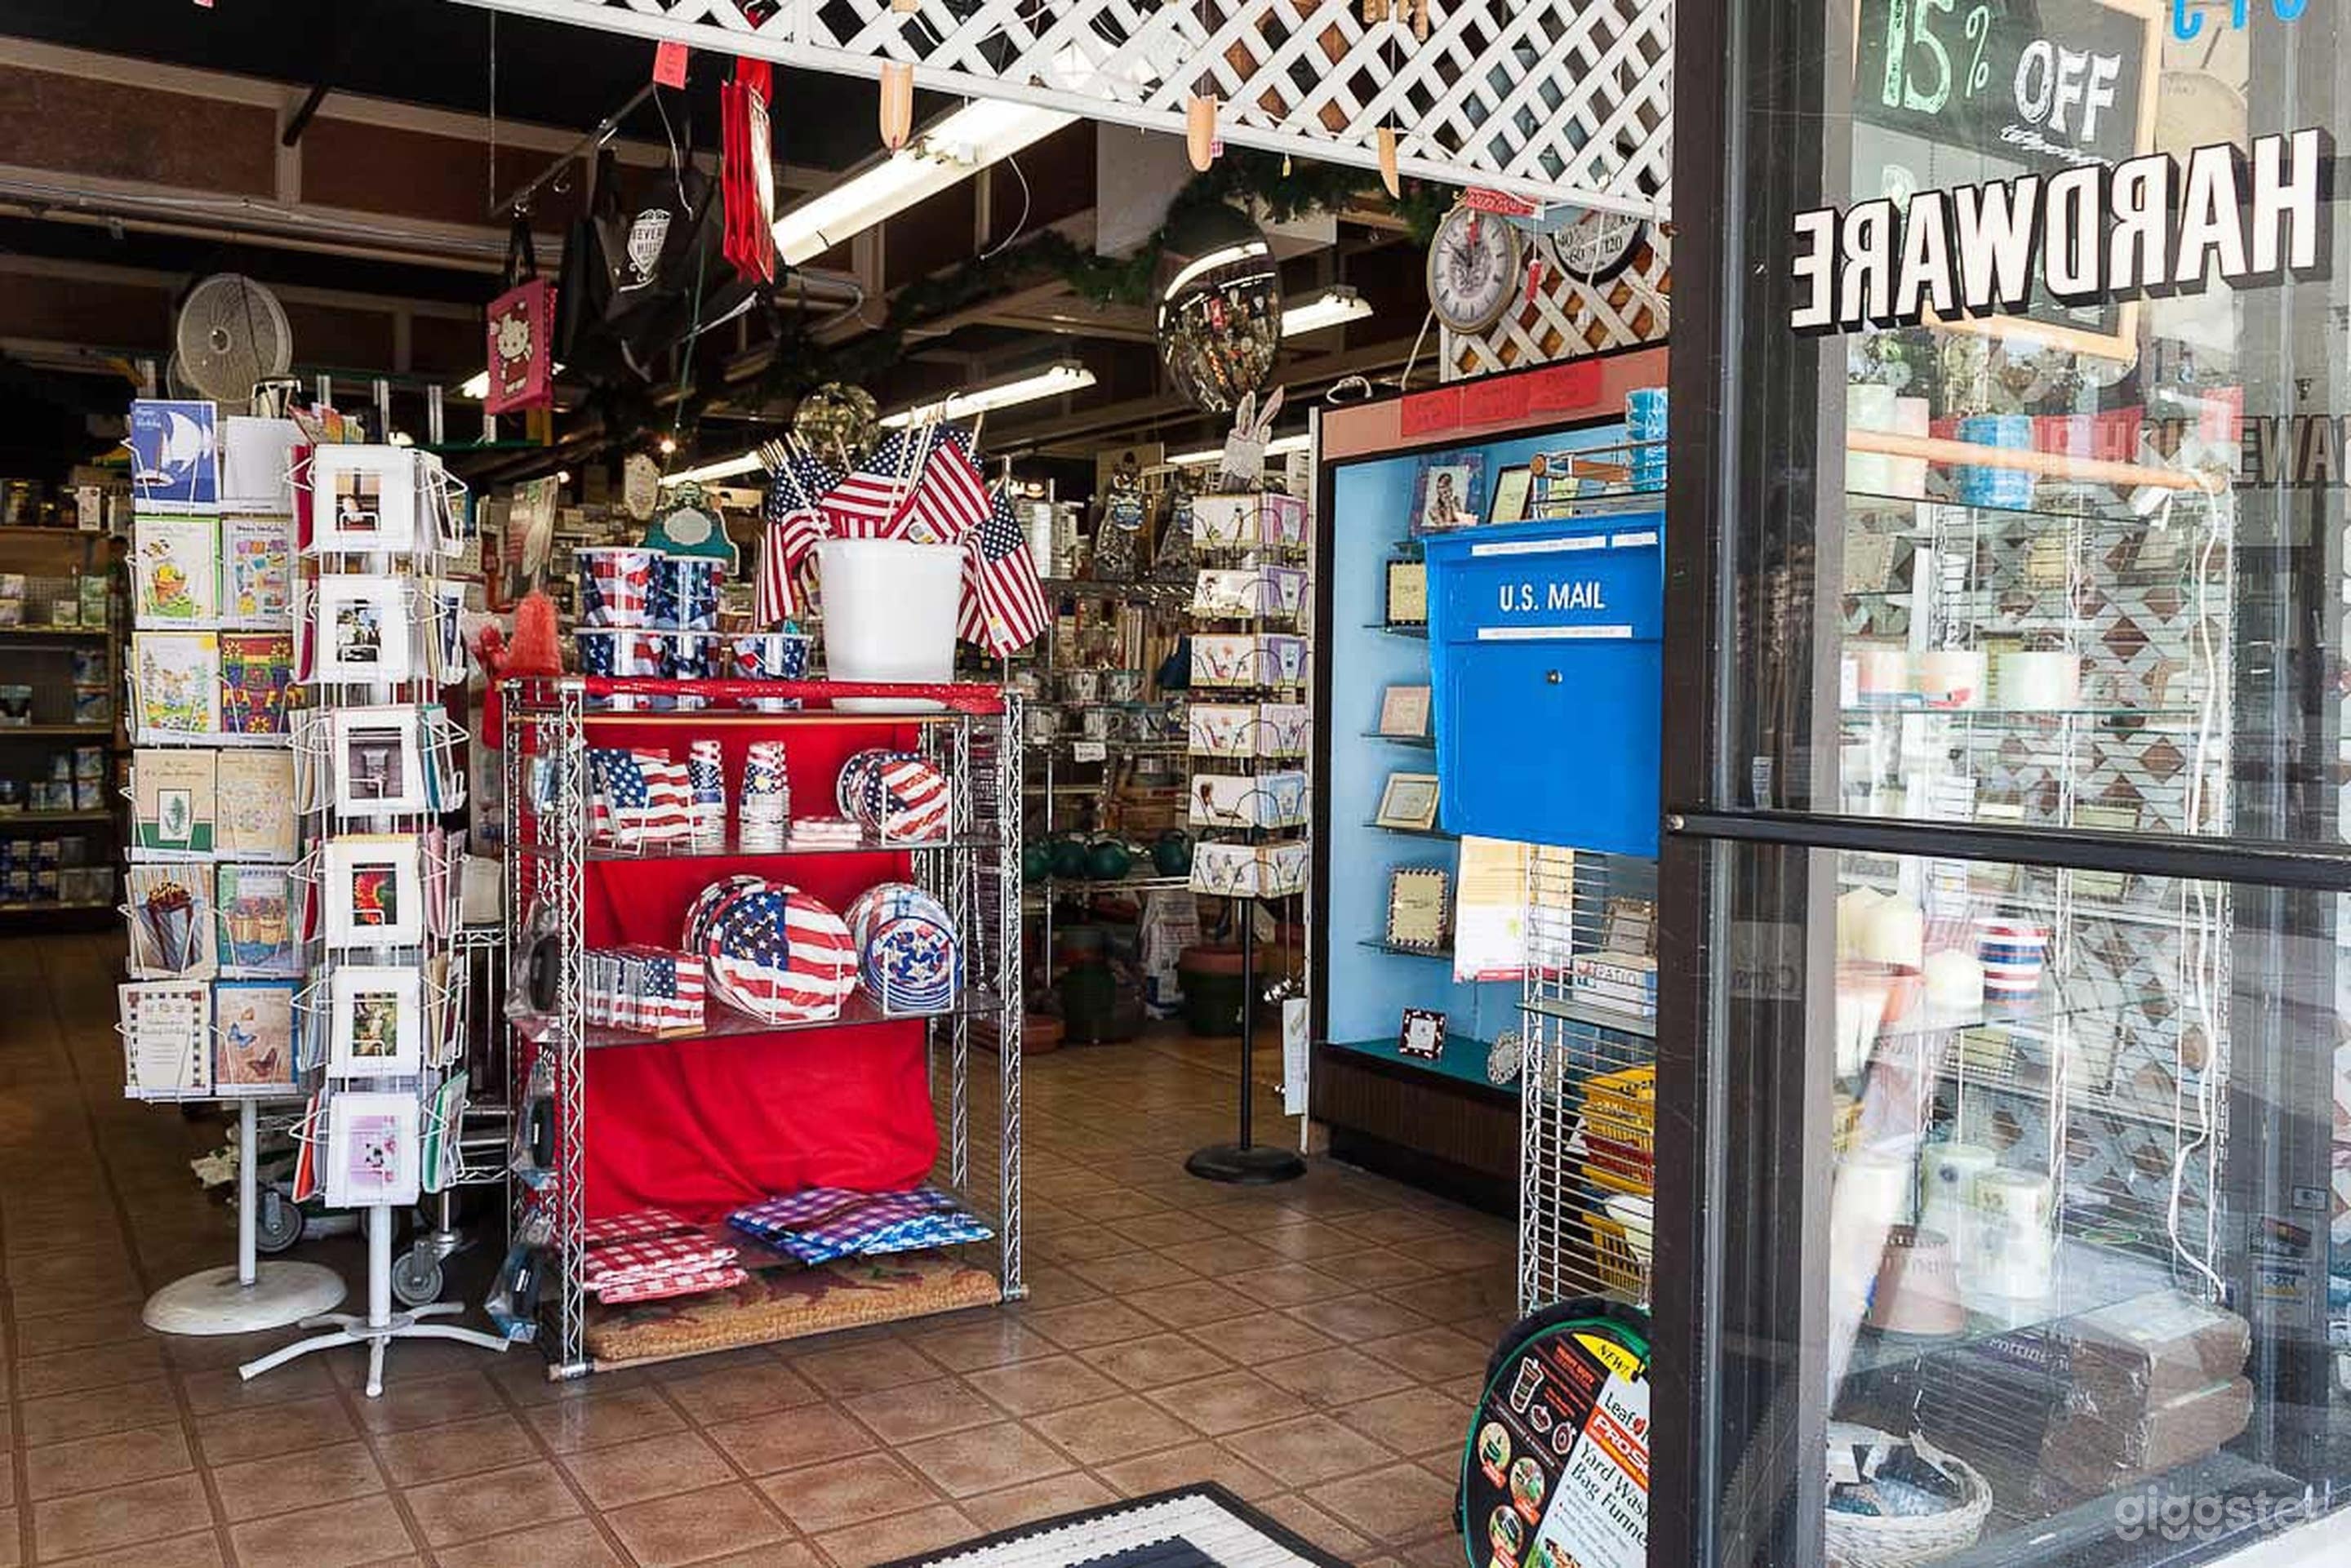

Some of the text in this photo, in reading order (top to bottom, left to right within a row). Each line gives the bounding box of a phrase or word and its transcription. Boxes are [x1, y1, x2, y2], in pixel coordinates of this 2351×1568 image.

[2014, 39, 2121, 142] OFF
[1500, 581, 1606, 612] U.S. MAIL
[1571, 1461, 1601, 1502] Bag
[1580, 1440, 1617, 1482] Yard
[1615, 1474, 1649, 1521] Was
